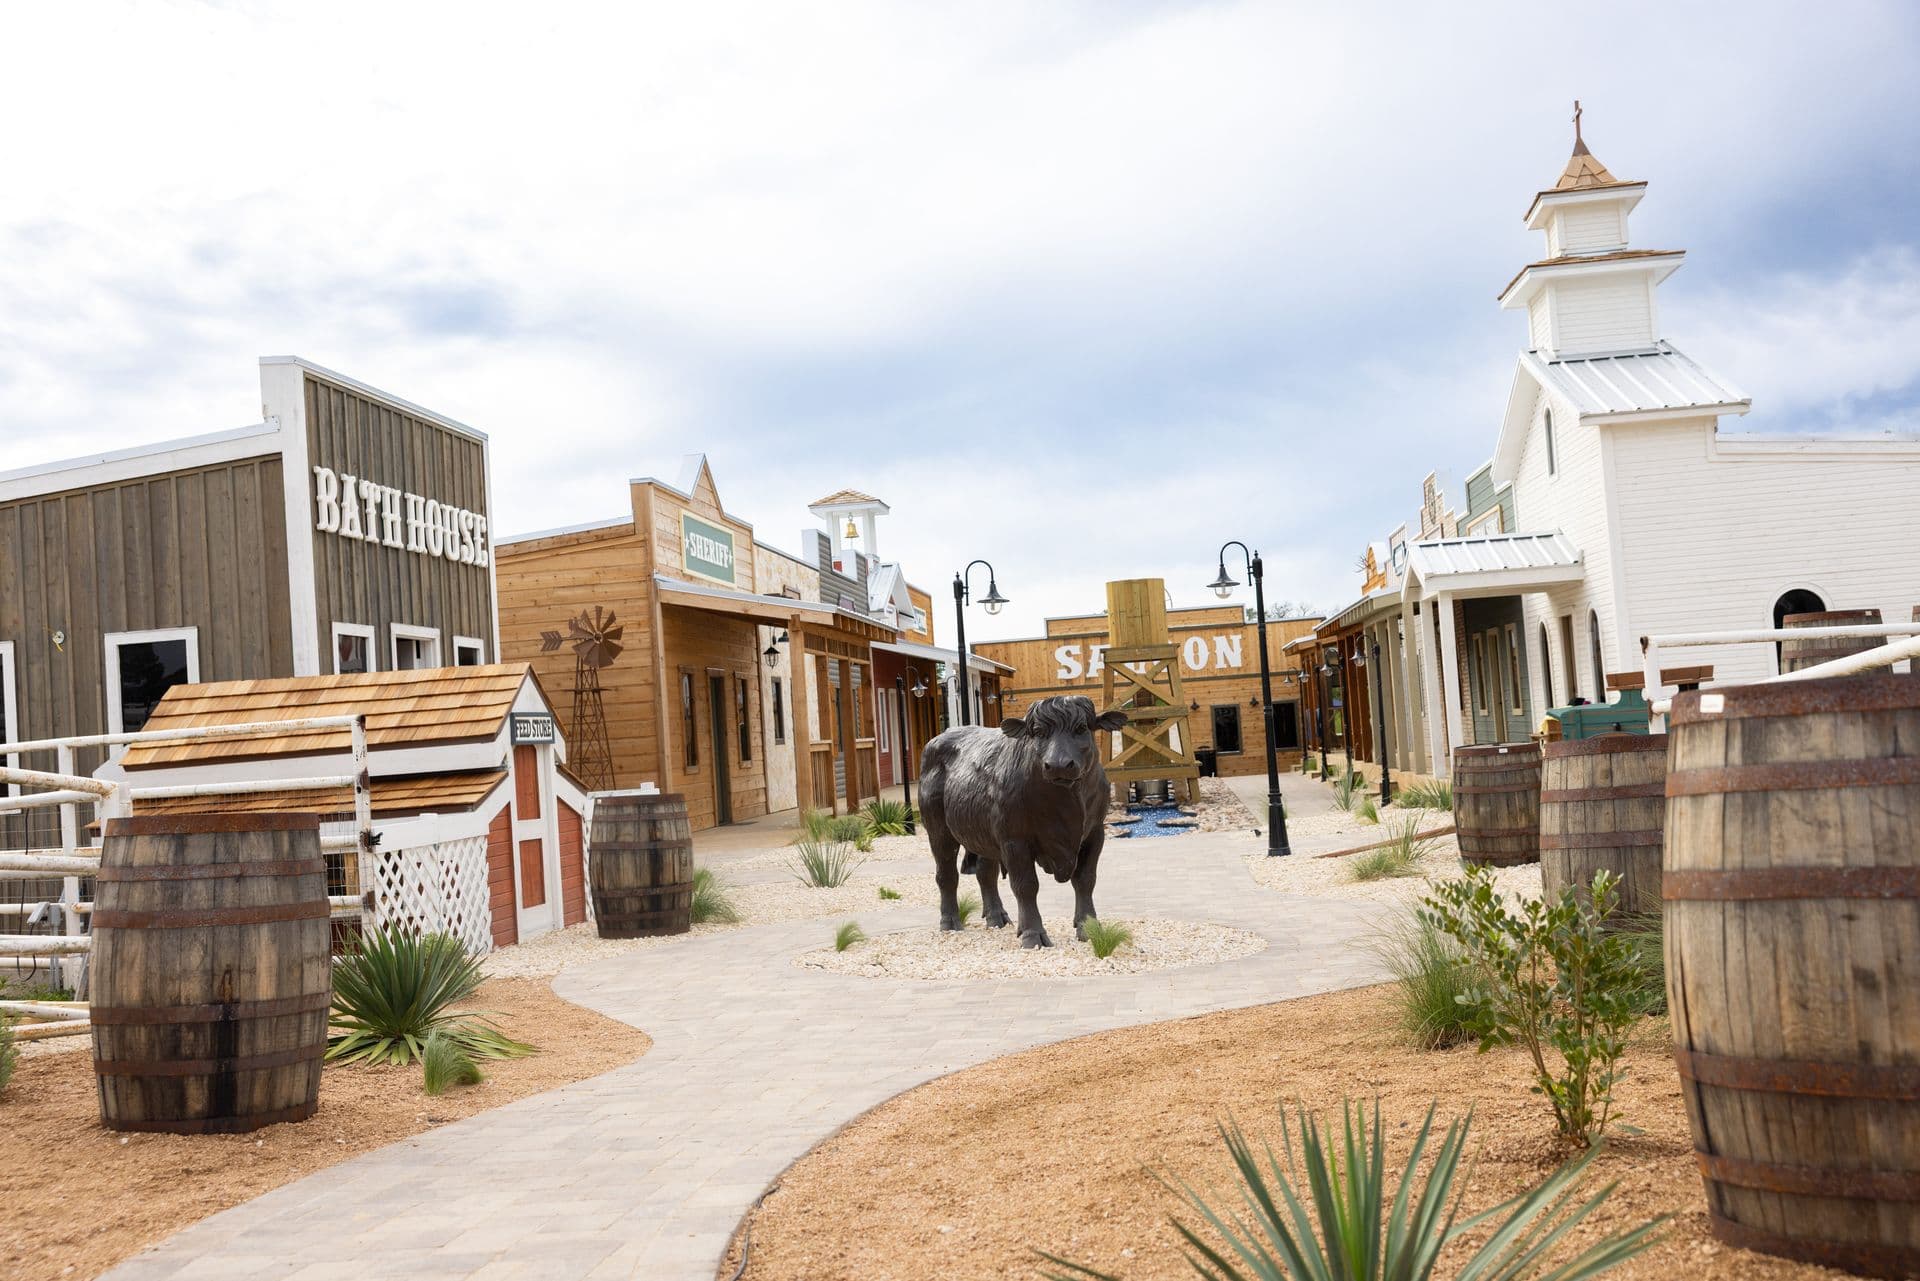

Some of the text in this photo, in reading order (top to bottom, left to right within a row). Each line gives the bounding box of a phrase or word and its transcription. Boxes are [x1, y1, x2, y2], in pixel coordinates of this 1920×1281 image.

[689, 532, 729, 568] SHERIFF
[1054, 634, 1242, 680] SAON
[515, 719, 551, 737] FEED STORE
